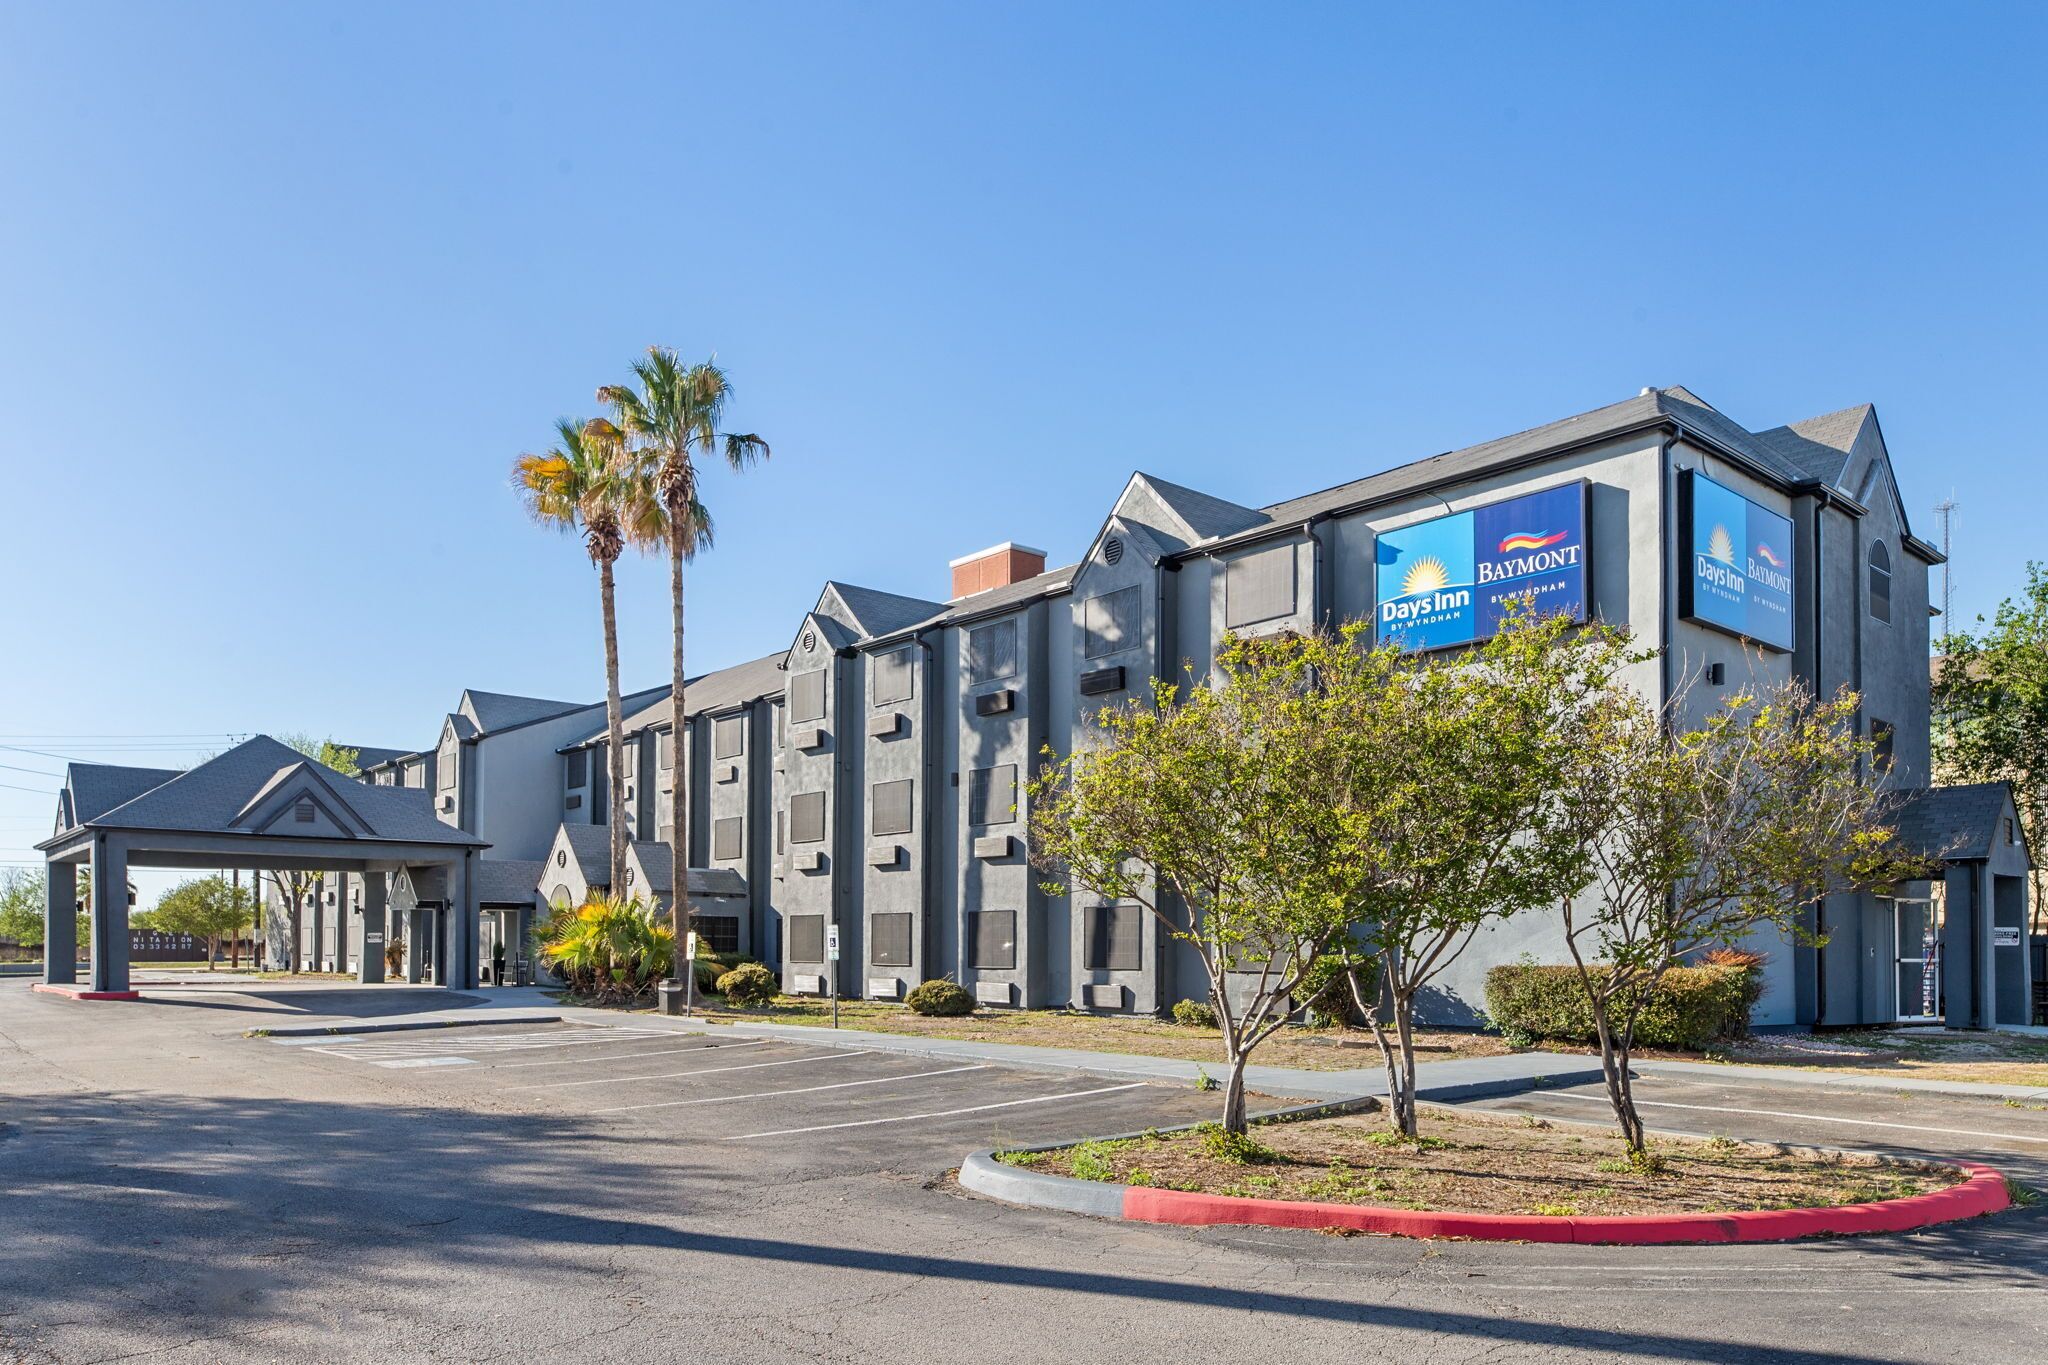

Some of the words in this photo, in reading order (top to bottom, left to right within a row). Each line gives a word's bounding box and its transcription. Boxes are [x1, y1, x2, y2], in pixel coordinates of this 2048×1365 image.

[1478, 545, 1580, 584] BAYMONT
[1698, 556, 1726, 586] Days
[1726, 567, 1744, 594] Inn
[1747, 557, 1791, 595] BAYMONT
[1382, 599, 1432, 621] Days
[1435, 590, 1469, 608] Inn
[1491, 595, 1503, 603] BY
[1508, 581, 1566, 599] WYNDHAM
[1391, 622, 1402, 631] BY
[1408, 611, 1460, 627] WYNDHAM
